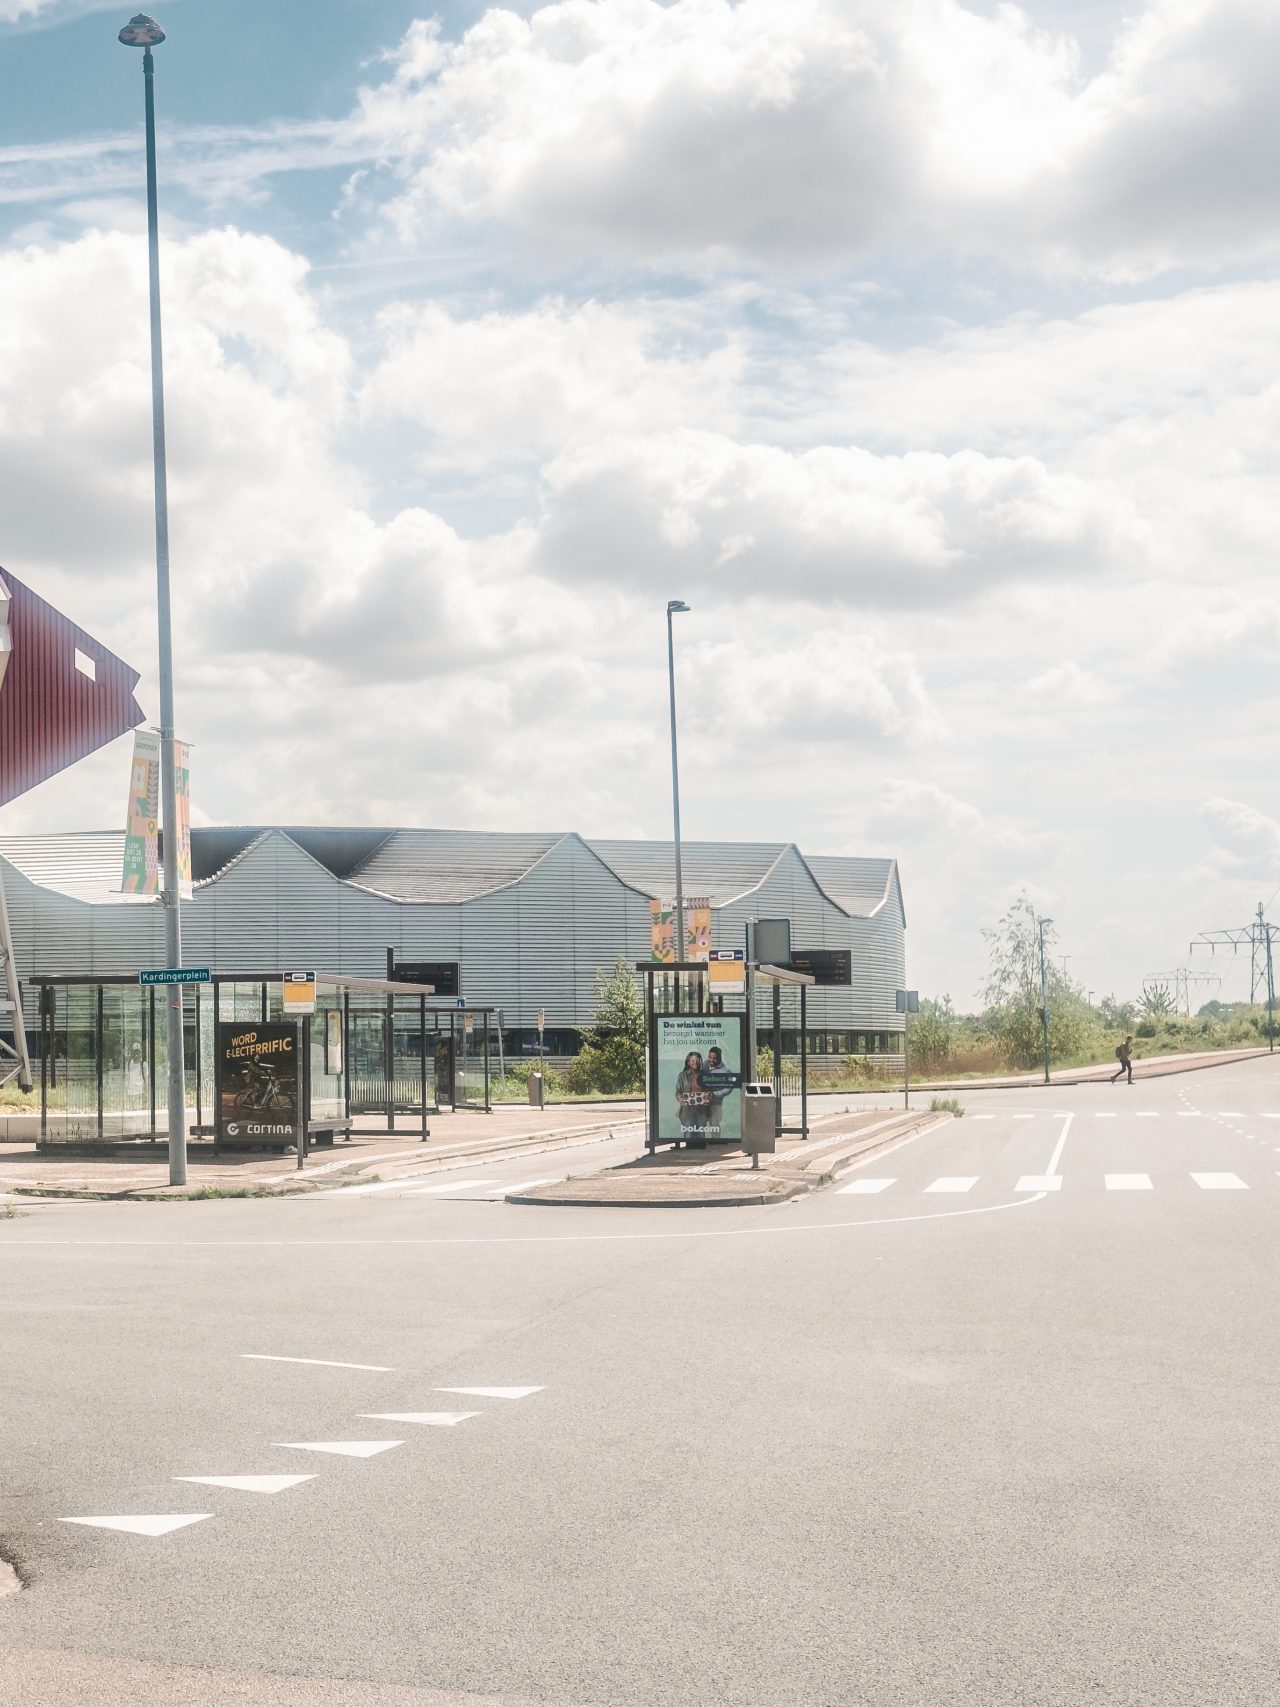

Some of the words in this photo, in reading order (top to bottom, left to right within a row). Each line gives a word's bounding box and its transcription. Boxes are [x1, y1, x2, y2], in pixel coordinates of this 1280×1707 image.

[142, 971, 208, 982] Kardingerplein
[663, 1030, 693, 1038] bezorgd
[232, 1032, 257, 1047] WORD
[680, 1124, 720, 1133] bol.com
